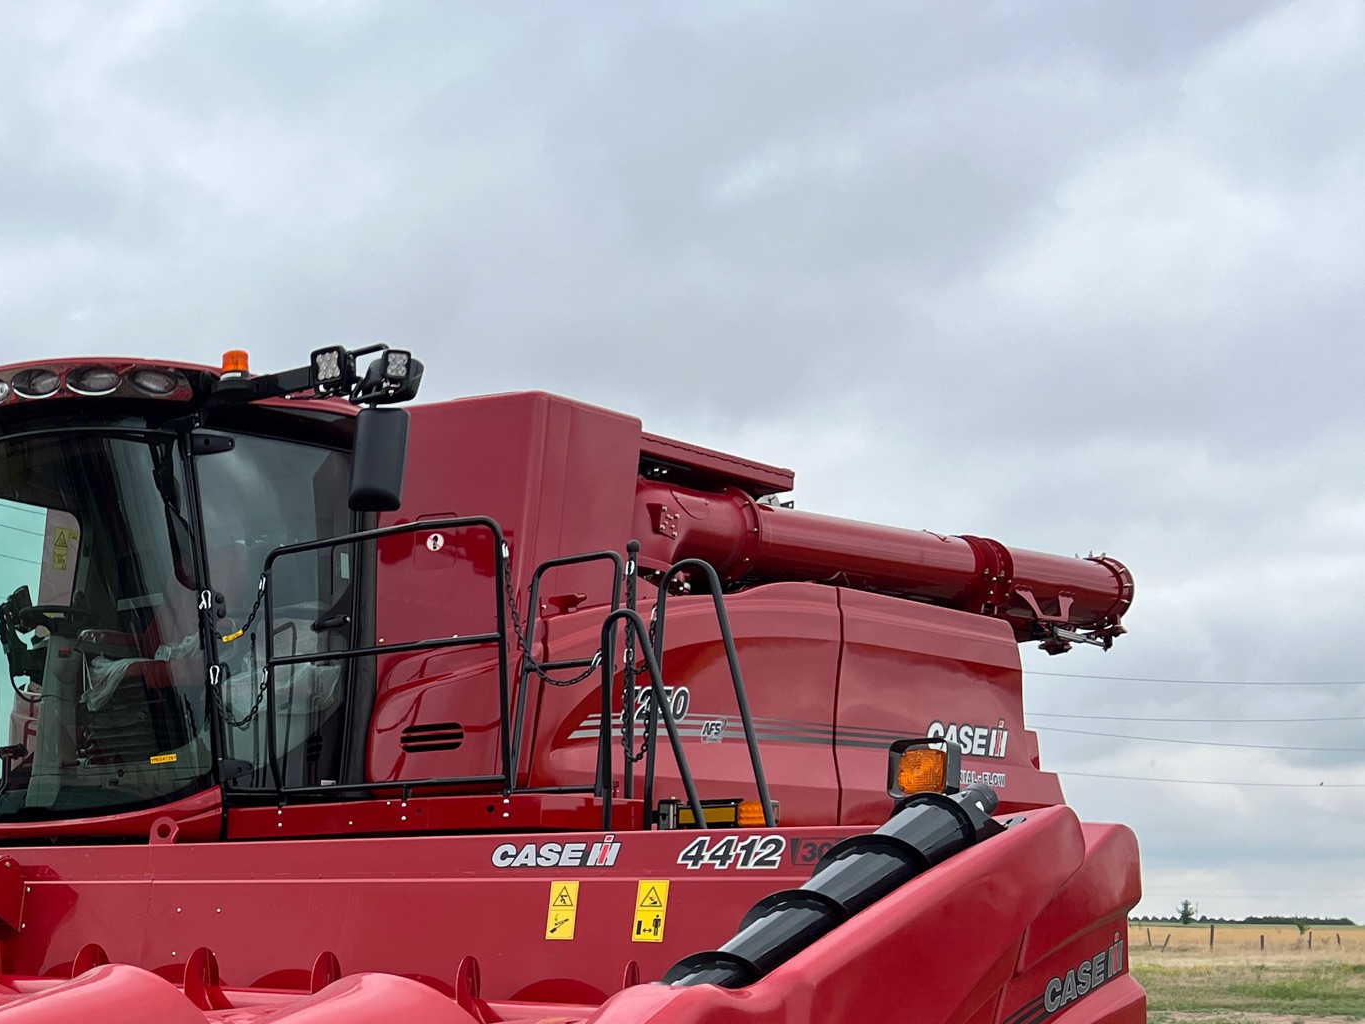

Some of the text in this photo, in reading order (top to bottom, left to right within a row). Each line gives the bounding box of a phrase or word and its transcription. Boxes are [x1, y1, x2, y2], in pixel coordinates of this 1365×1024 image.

[701, 721, 722, 736] AFS
[927, 721, 989, 756] CASE
[491, 842, 587, 868] CASE
[677, 835, 787, 870] 4412
[1044, 951, 1106, 1013] CASE
